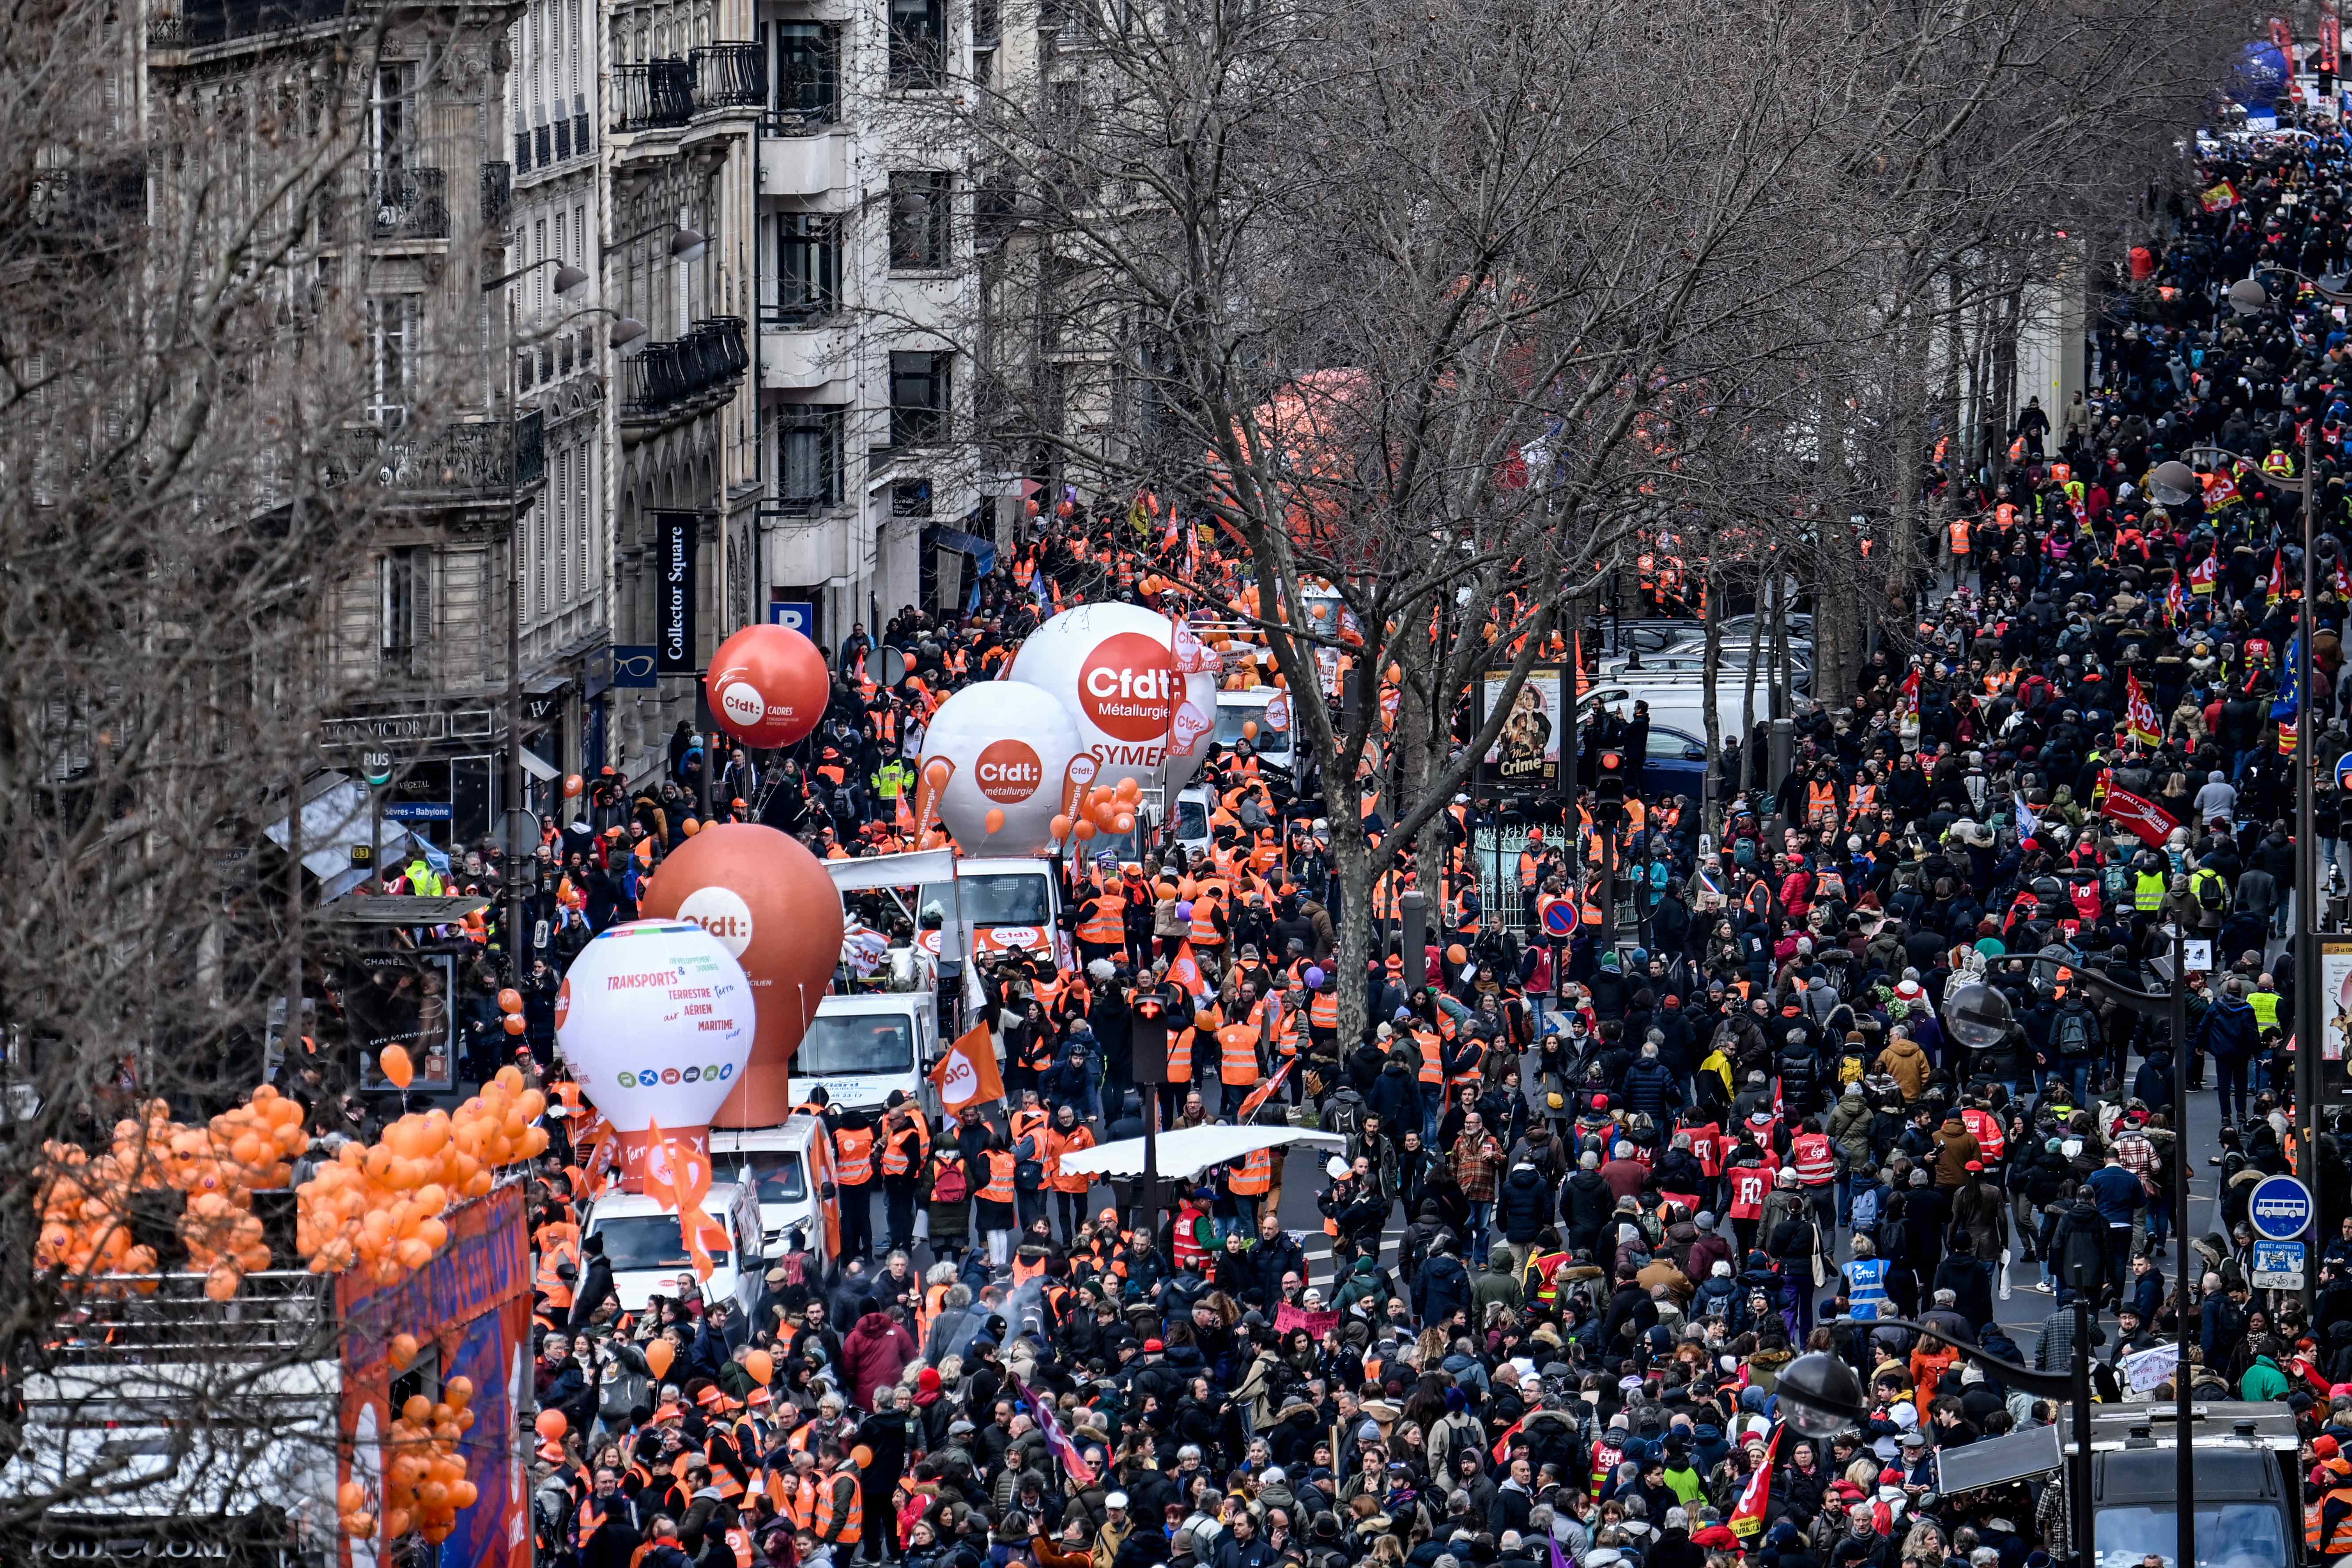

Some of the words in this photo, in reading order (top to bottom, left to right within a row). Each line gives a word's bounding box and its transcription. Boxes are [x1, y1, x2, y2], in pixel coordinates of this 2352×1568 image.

[668, 526, 686, 582] Square
[668, 586, 683, 660] Collector
[1087, 667, 1180, 700] Cfdt:
[725, 696, 760, 715] Cfdt:
[767, 706, 793, 715] CADRES
[1098, 703, 1171, 720] Métallurgie
[2135, 702, 2155, 730] cg
[368, 721, 420, 736] VICTOR
[364, 753, 389, 767] BUS
[1509, 749, 1530, 759] Mon
[980, 763, 1037, 781] Cfdt:
[1071, 767, 1093, 775] Cfdt:
[1501, 758, 1542, 776] Crime
[985, 786, 1033, 796] métallurgie
[416, 808, 449, 817] Babylone
[919, 788, 935, 835] métallurgie
[354, 849, 367, 858] 83
[2078, 886, 2090, 898] FO
[2065, 927, 2075, 939] gt
[854, 946, 878, 964] Cfd
[608, 971, 678, 990] TRANSPORTS
[668, 988, 711, 1000] TERRESTRE
[663, 1011, 680, 1022] air
[684, 1003, 712, 1016] AÉRIEN
[698, 1019, 733, 1032] MARITIME
[1694, 1140, 1711, 1160] FO
[1811, 1147, 1826, 1158] cgt
[1856, 1270, 1875, 1279] cftc
[1599, 1452, 1621, 1467] cgt
